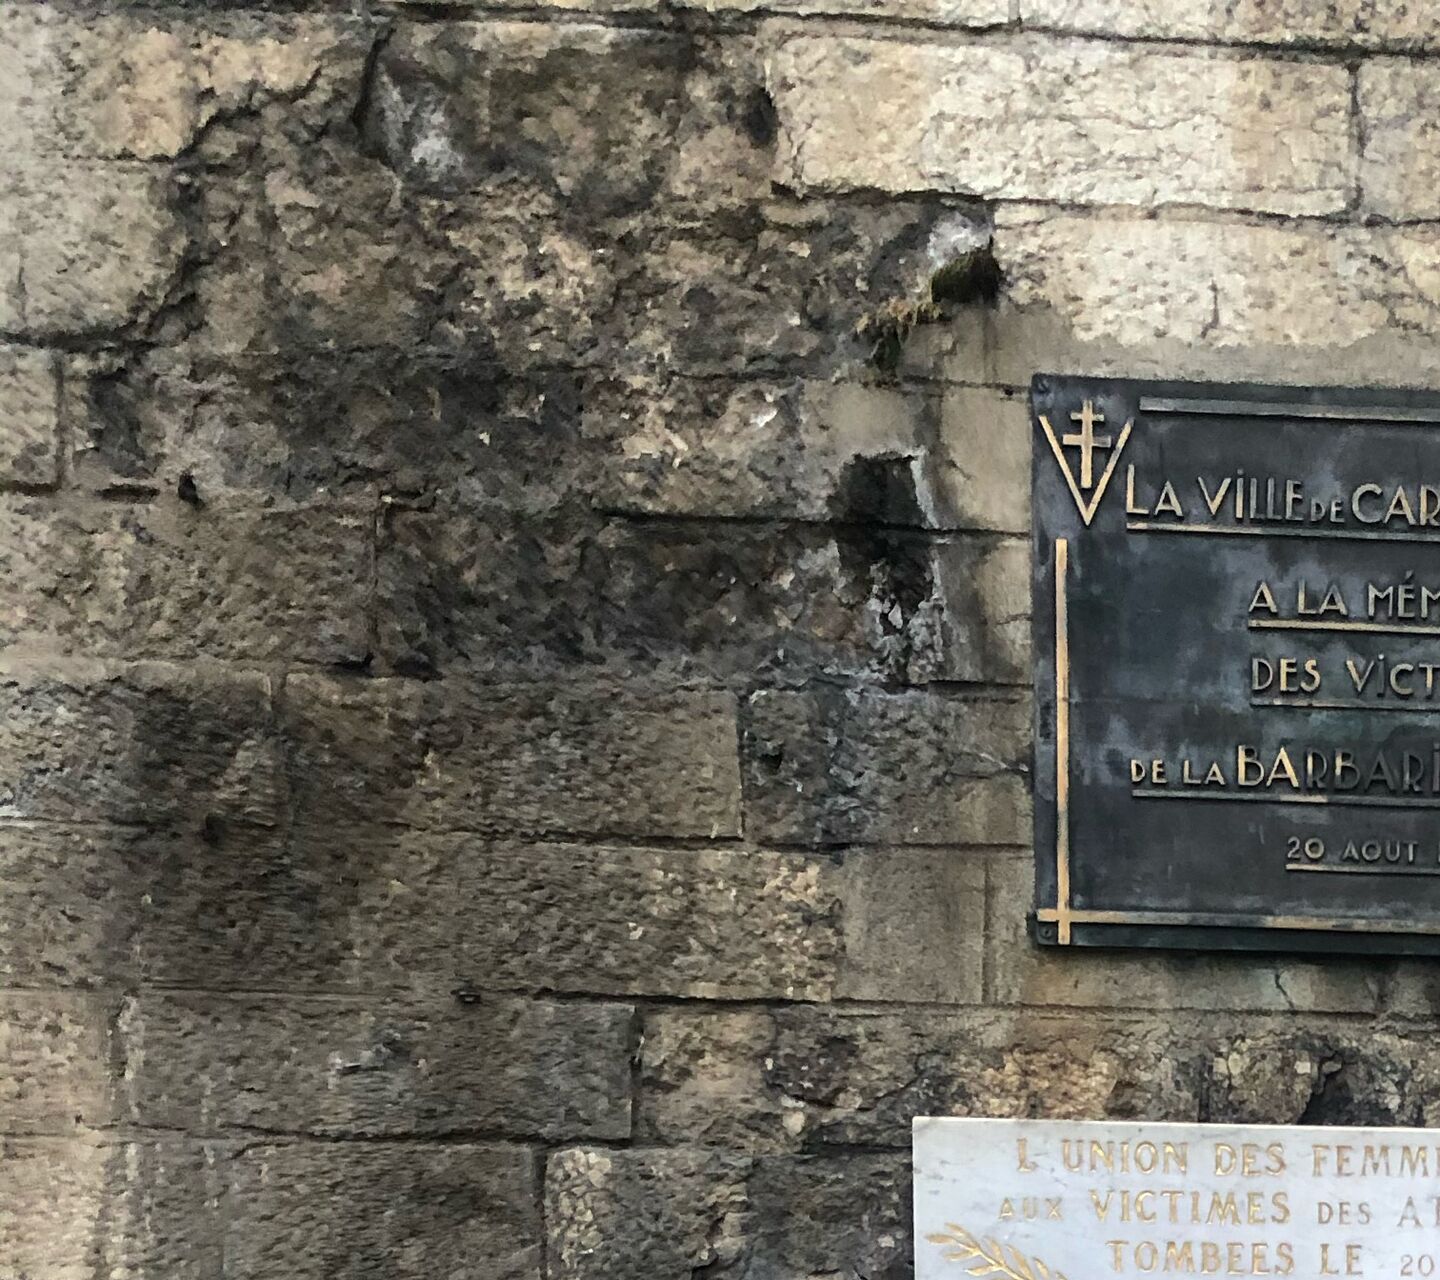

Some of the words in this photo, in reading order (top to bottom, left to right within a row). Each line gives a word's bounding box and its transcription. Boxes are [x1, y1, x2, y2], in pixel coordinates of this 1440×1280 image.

[1126, 463, 1183, 517] LA
[1198, 468, 1304, 521] VILLE
[1310, 495, 1345, 523] DE
[1249, 581, 1278, 613] A
[1297, 579, 1348, 616] LA
[1251, 657, 1321, 693] DES
[1130, 758, 1168, 785] DE
[1182, 760, 1225, 786] LA
[1287, 836, 1325, 860] 20
[1342, 838, 1418, 864] AOUT
[1213, 1142, 1288, 1176] DES
[998, 1196, 1063, 1223] AUX
[1088, 1189, 1291, 1226] VICTIMES
[1316, 1201, 1373, 1226] DES
[1105, 1240, 1294, 1276] TOMBEES
[1319, 1243, 1364, 1276] LE
[1399, 1253, 1435, 1277] 20
